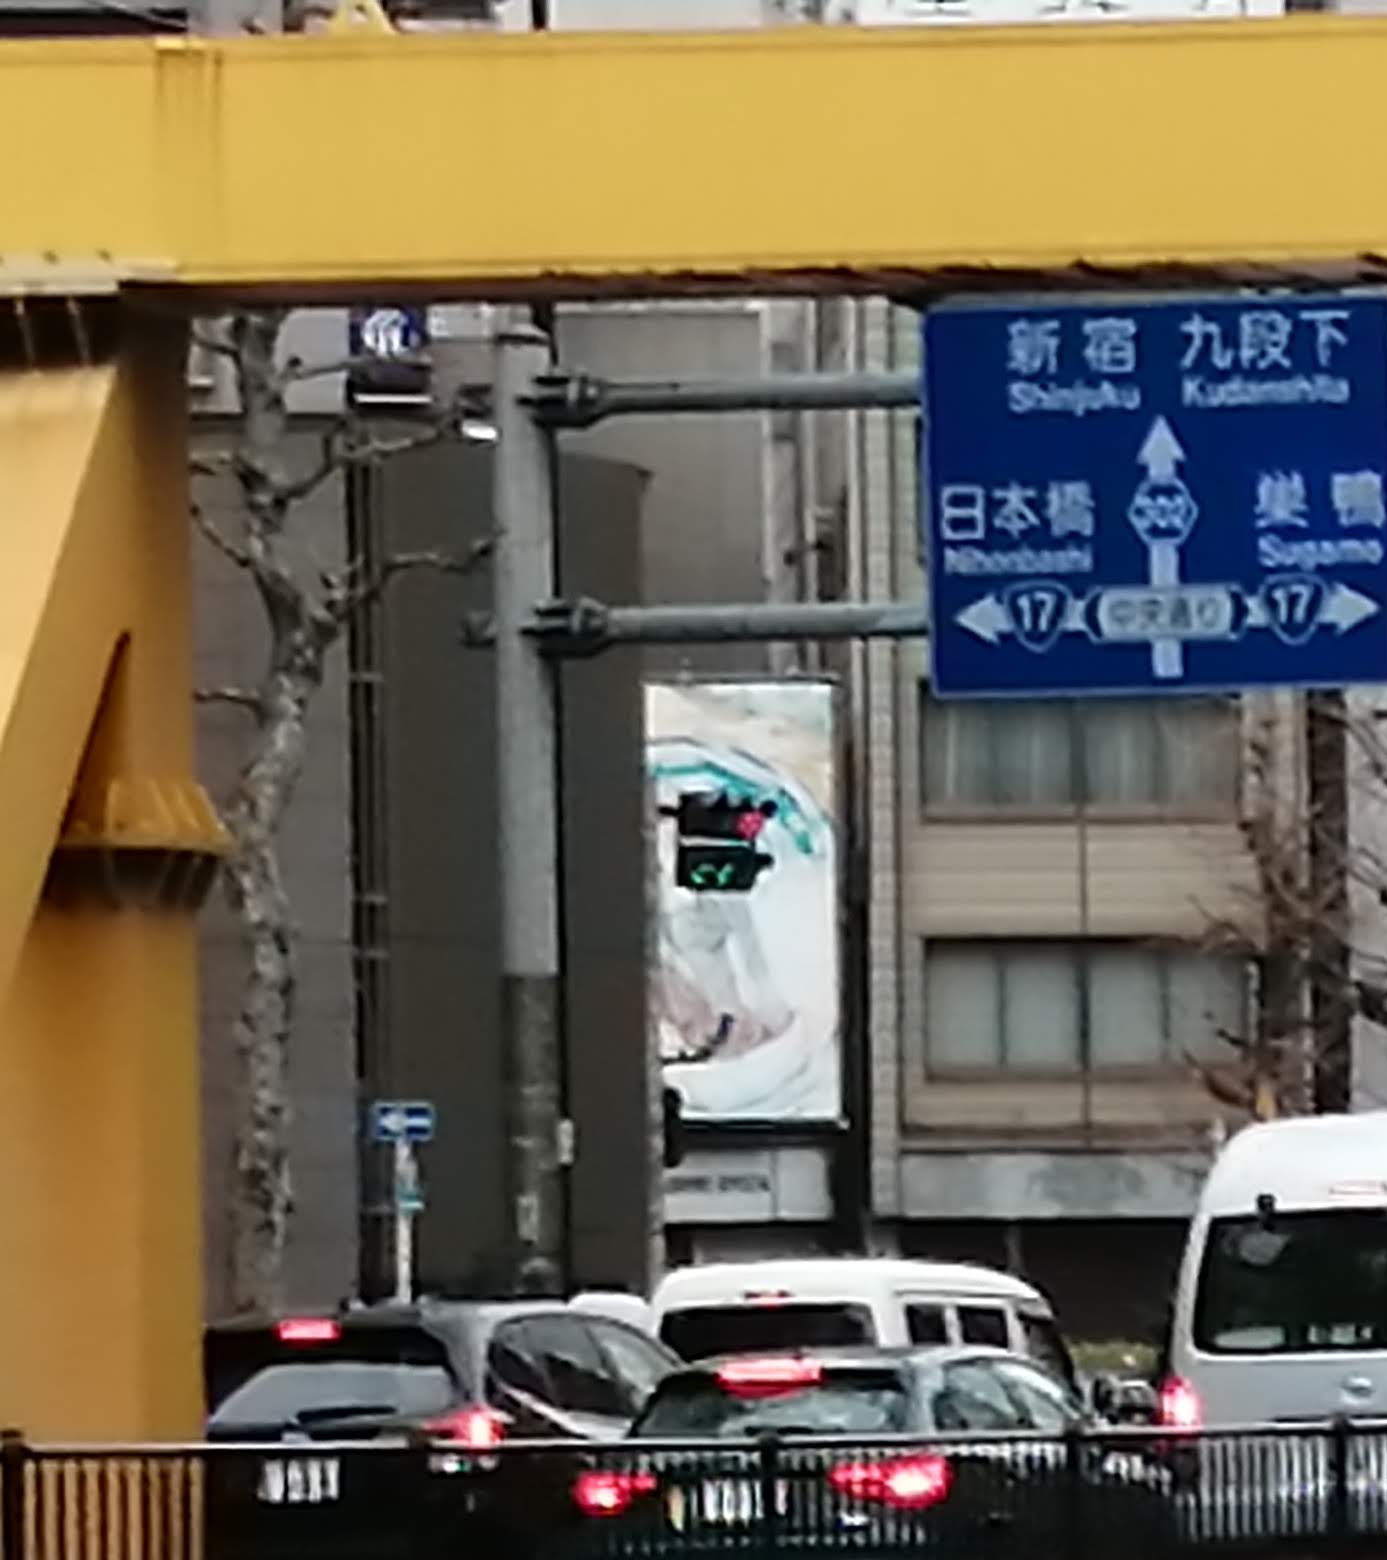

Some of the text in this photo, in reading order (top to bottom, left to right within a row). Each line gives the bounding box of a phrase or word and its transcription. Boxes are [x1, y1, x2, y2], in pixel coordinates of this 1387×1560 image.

[1008, 311, 1350, 374] 新宿 九段下
[940, 479, 1096, 540] 日本橋
[1016, 591, 1057, 632] 17
[1271, 583, 1314, 624] 17
